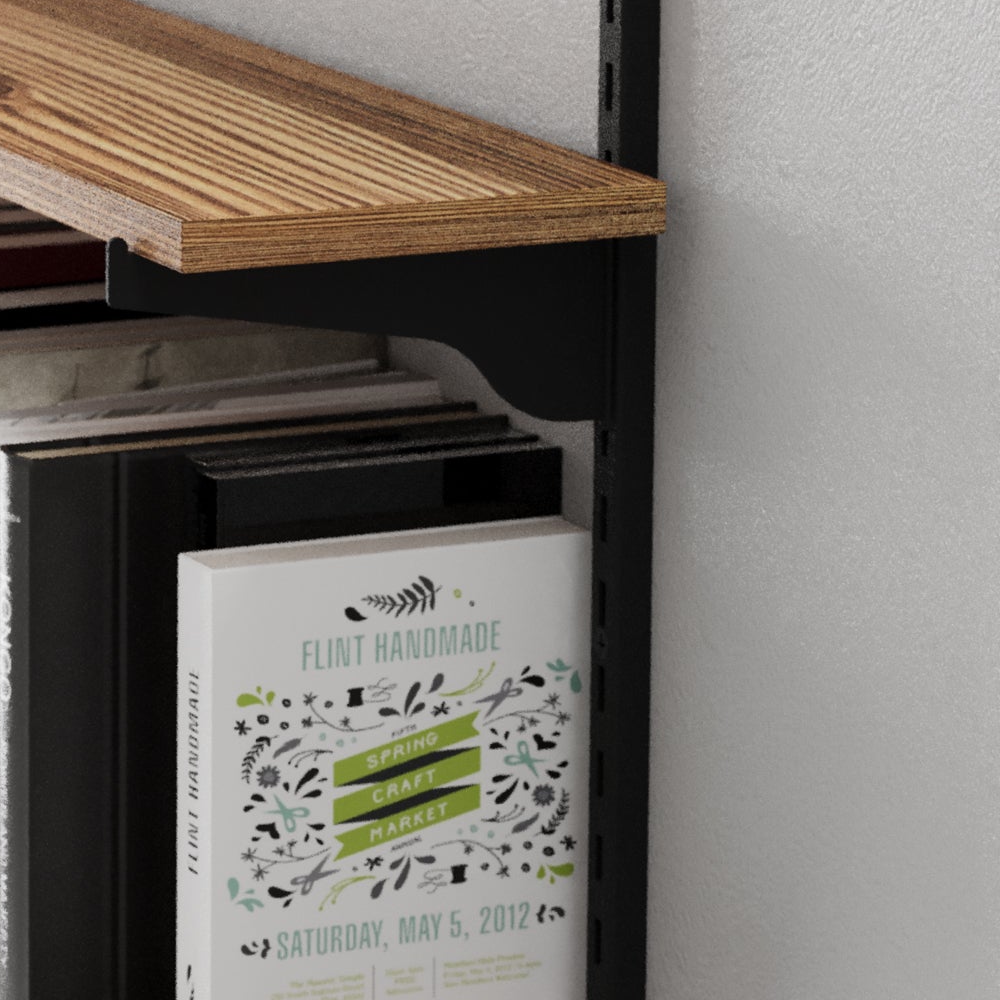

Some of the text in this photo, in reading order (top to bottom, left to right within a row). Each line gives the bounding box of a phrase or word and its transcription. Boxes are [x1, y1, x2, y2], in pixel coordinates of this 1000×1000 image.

[0, 573, 12, 703] KONGO
[301, 620, 502, 671] FLINT HANDMADE
[187, 668, 199, 875] FLINT HANDMADE
[366, 731, 439, 769] SPRING
[372, 769, 437, 803] CRAFT
[369, 803, 449, 843] MARKET
[277, 902, 531, 961] SATURDAY, MAY 5, 2012
